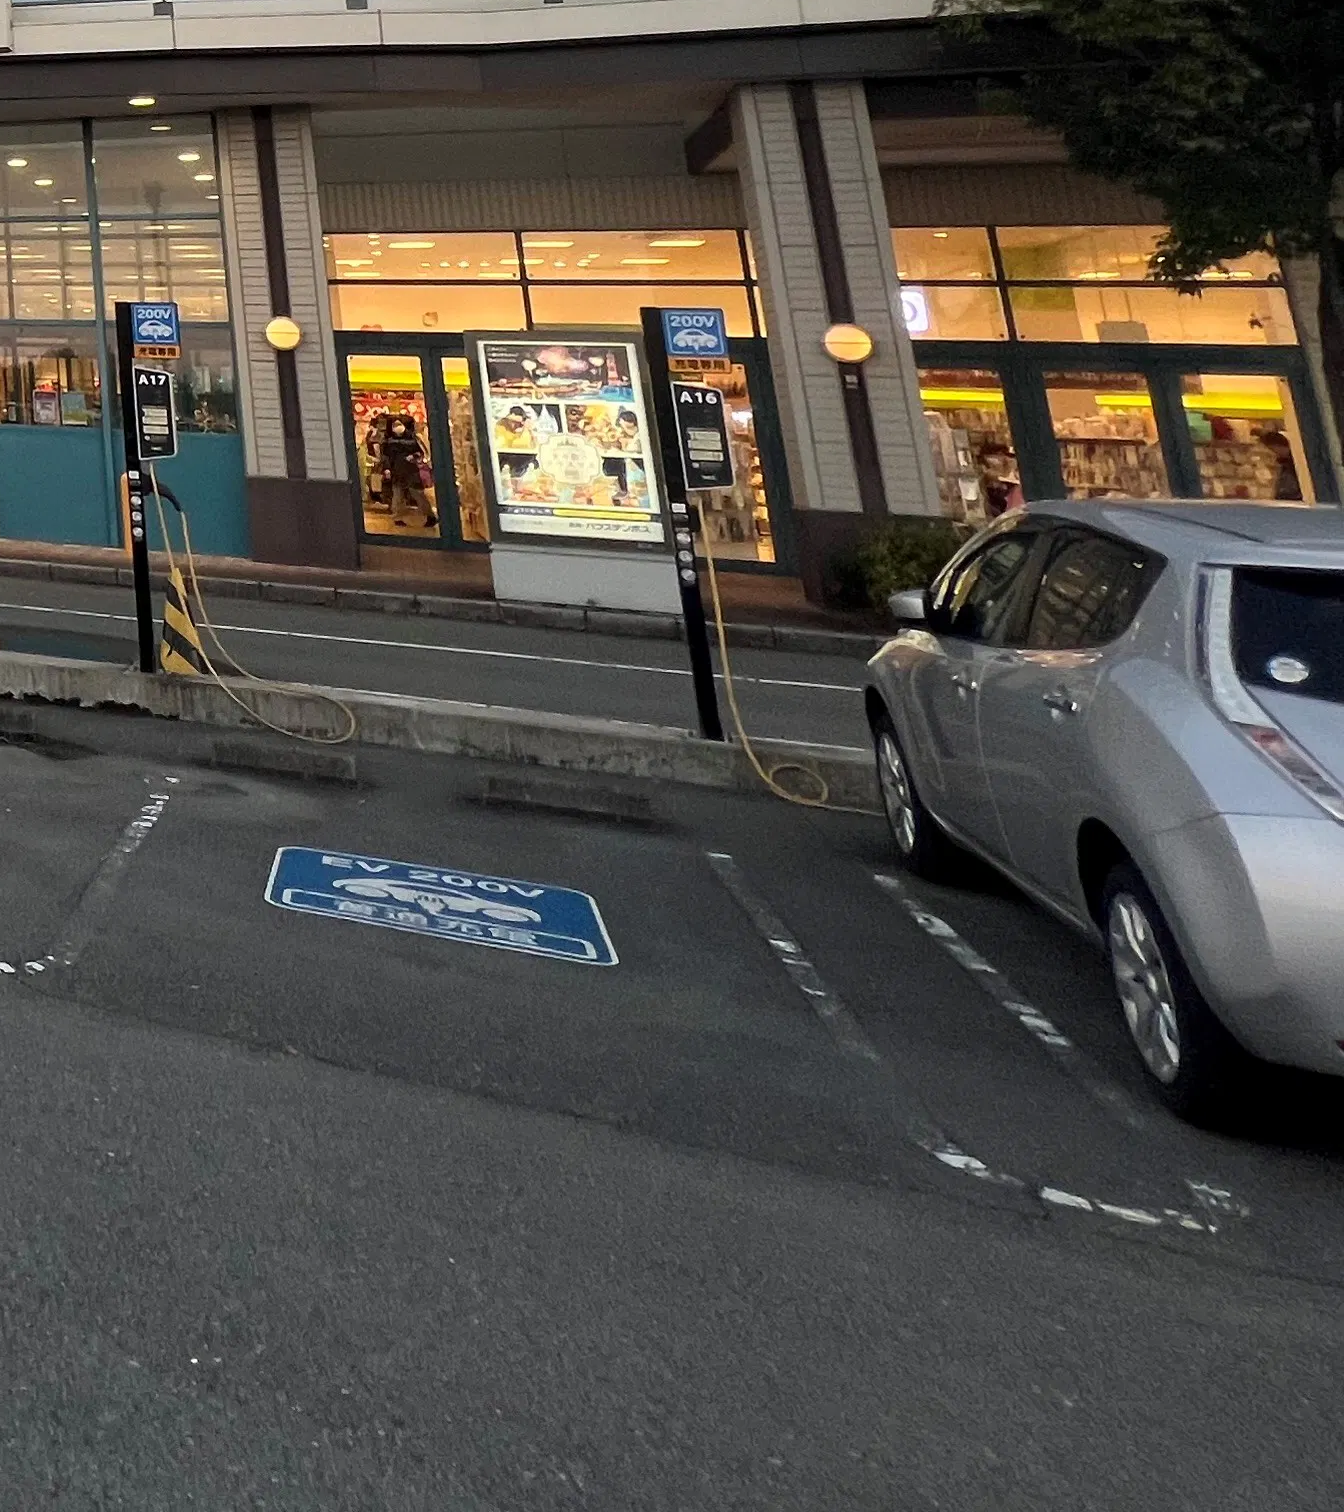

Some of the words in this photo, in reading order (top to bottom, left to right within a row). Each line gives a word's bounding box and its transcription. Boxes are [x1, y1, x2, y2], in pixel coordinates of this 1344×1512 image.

[137, 309, 171, 319] 200V
[670, 315, 715, 328] 200V
[138, 374, 167, 386] A17
[680, 391, 718, 405] A16
[321, 854, 390, 874] EV
[408, 869, 544, 898] 200V
